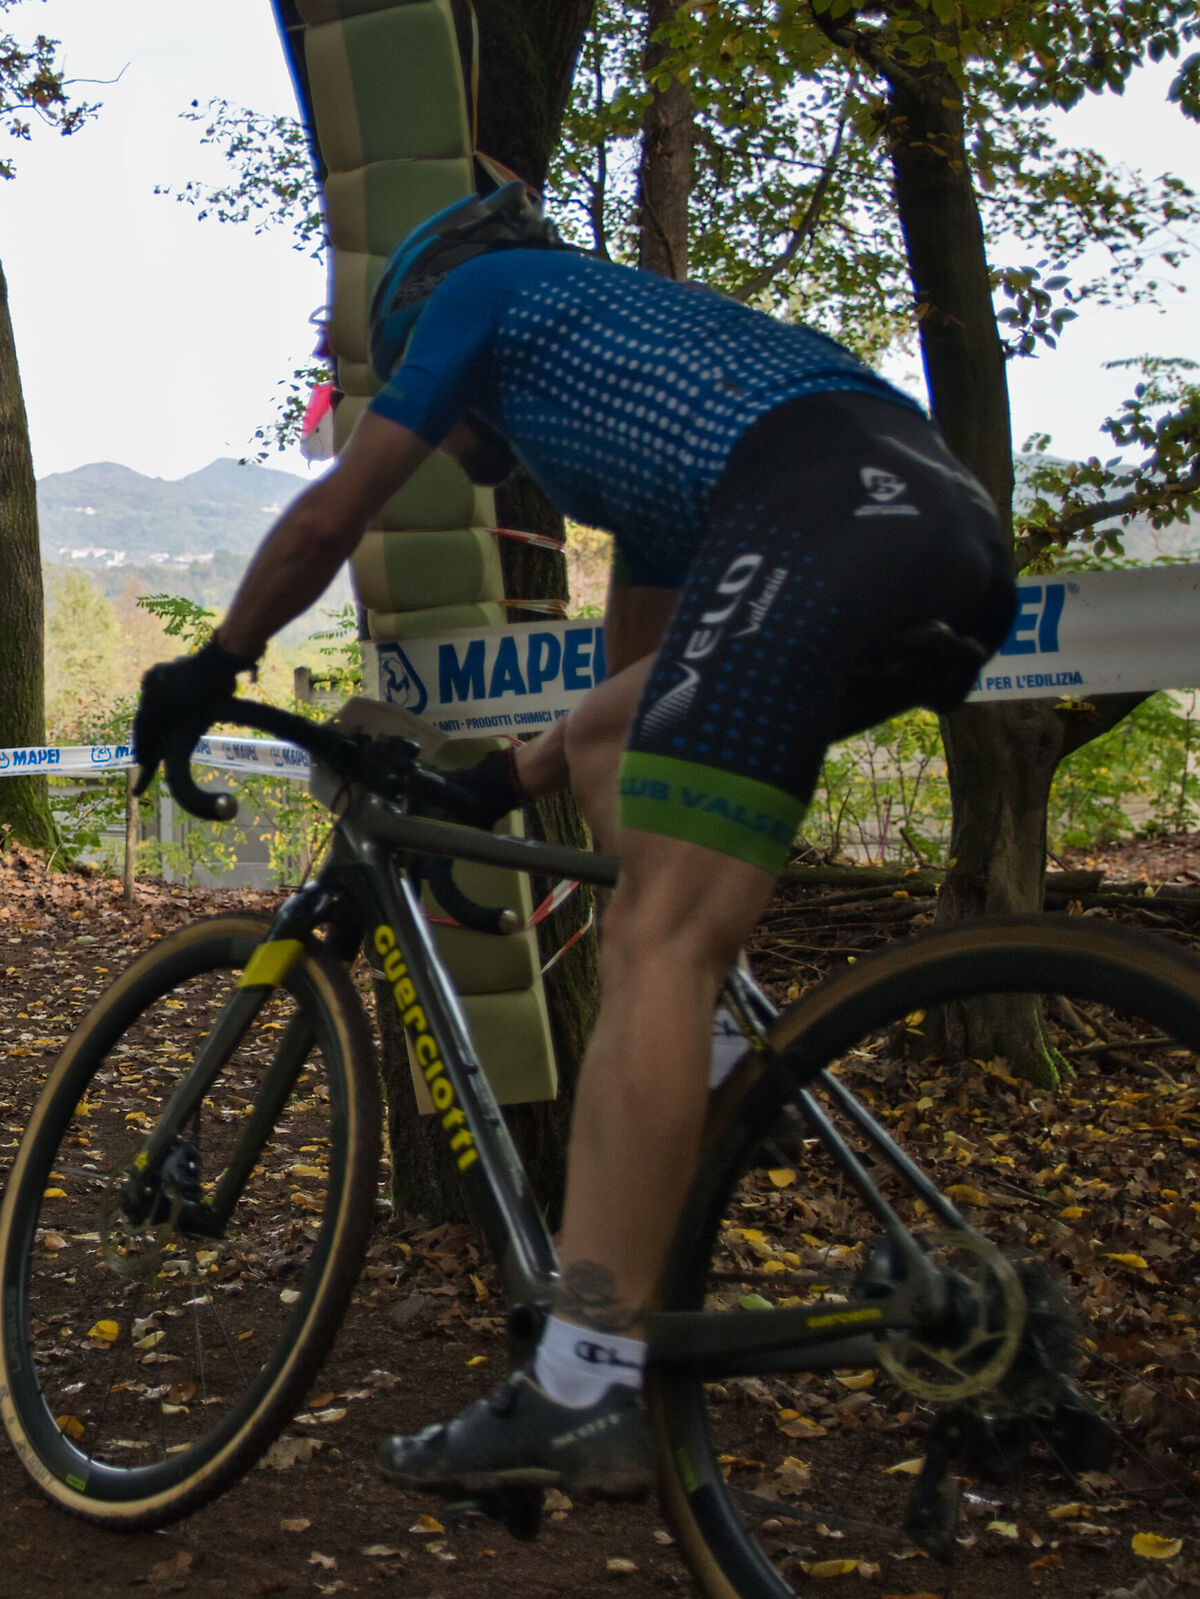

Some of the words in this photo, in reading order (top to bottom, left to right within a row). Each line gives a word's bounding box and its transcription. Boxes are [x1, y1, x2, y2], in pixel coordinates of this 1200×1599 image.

[986, 676, 1012, 690] PER
[1016, 671, 1084, 689] L'EDILIZIA
[466, 714, 512, 730] PRODOTTI
[514, 711, 551, 726] CHIMICI
[13, 748, 60, 766] MAPEI
